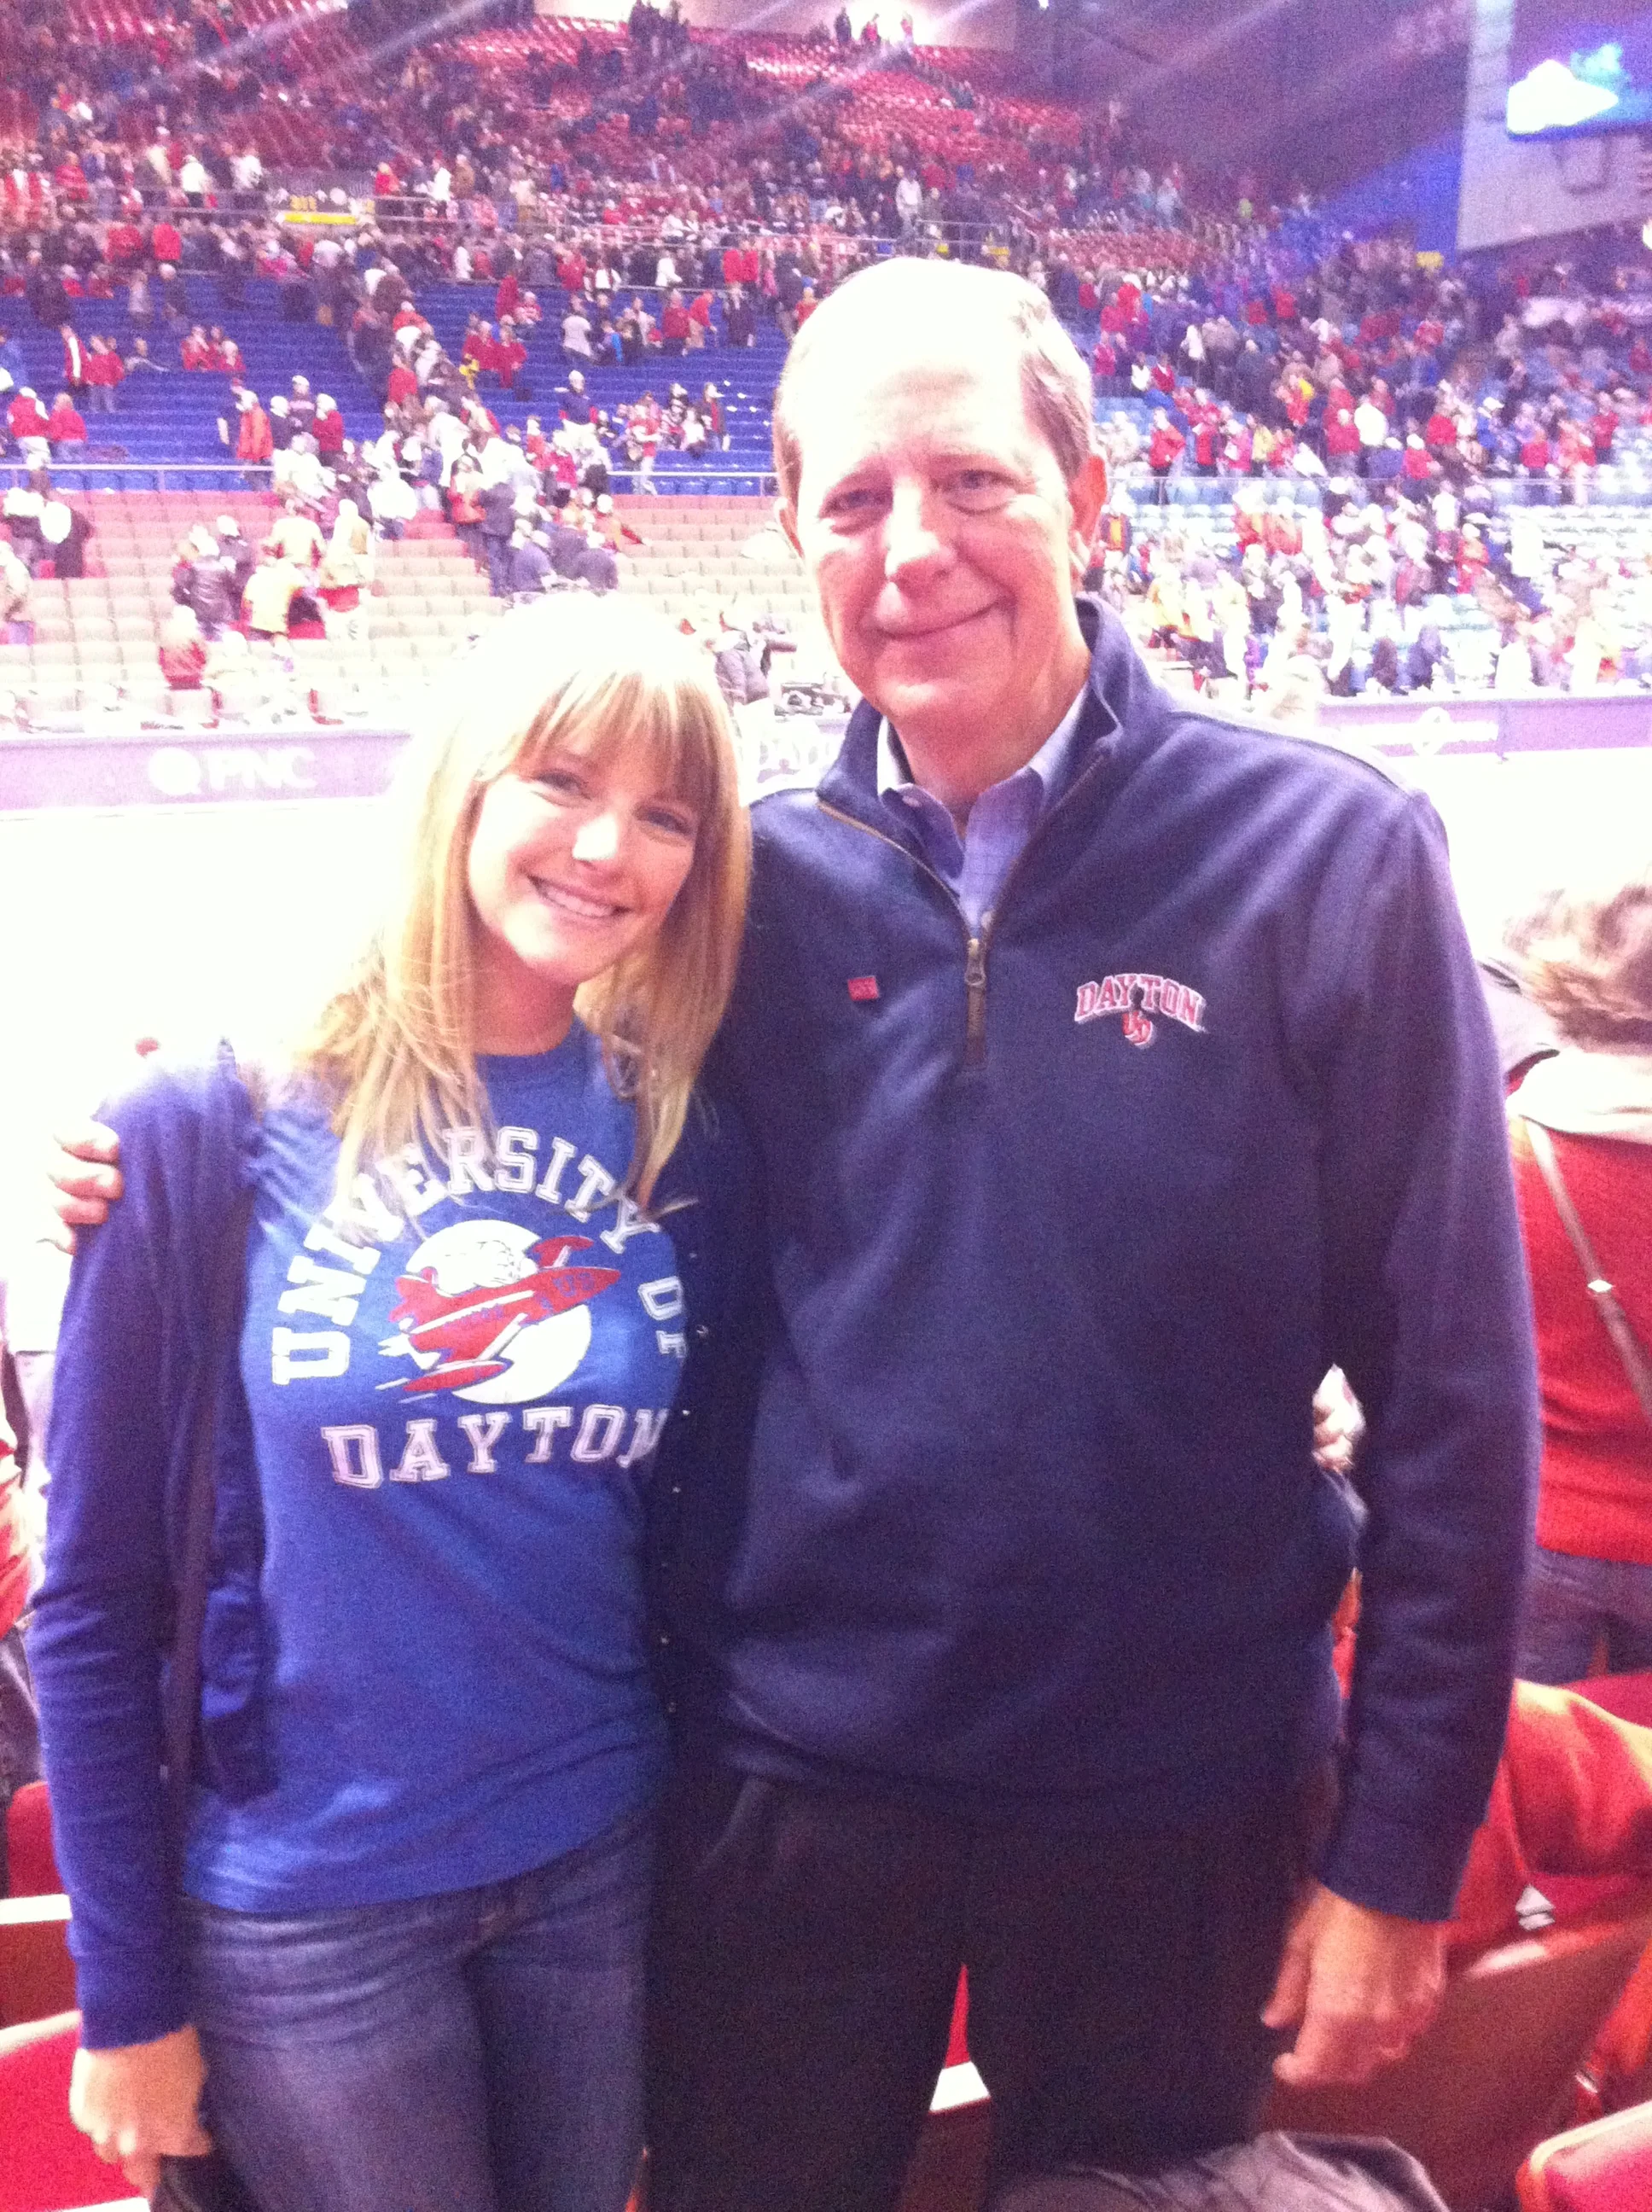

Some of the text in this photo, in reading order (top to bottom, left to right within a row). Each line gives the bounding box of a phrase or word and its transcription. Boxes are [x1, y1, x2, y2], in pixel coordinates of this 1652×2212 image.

[202, 746, 317, 790] PNC
[1074, 973, 1207, 1032] DAYTON
[271, 1126, 687, 1385] UNIVERSITY OF
[321, 1404, 669, 1489] DAYTON
